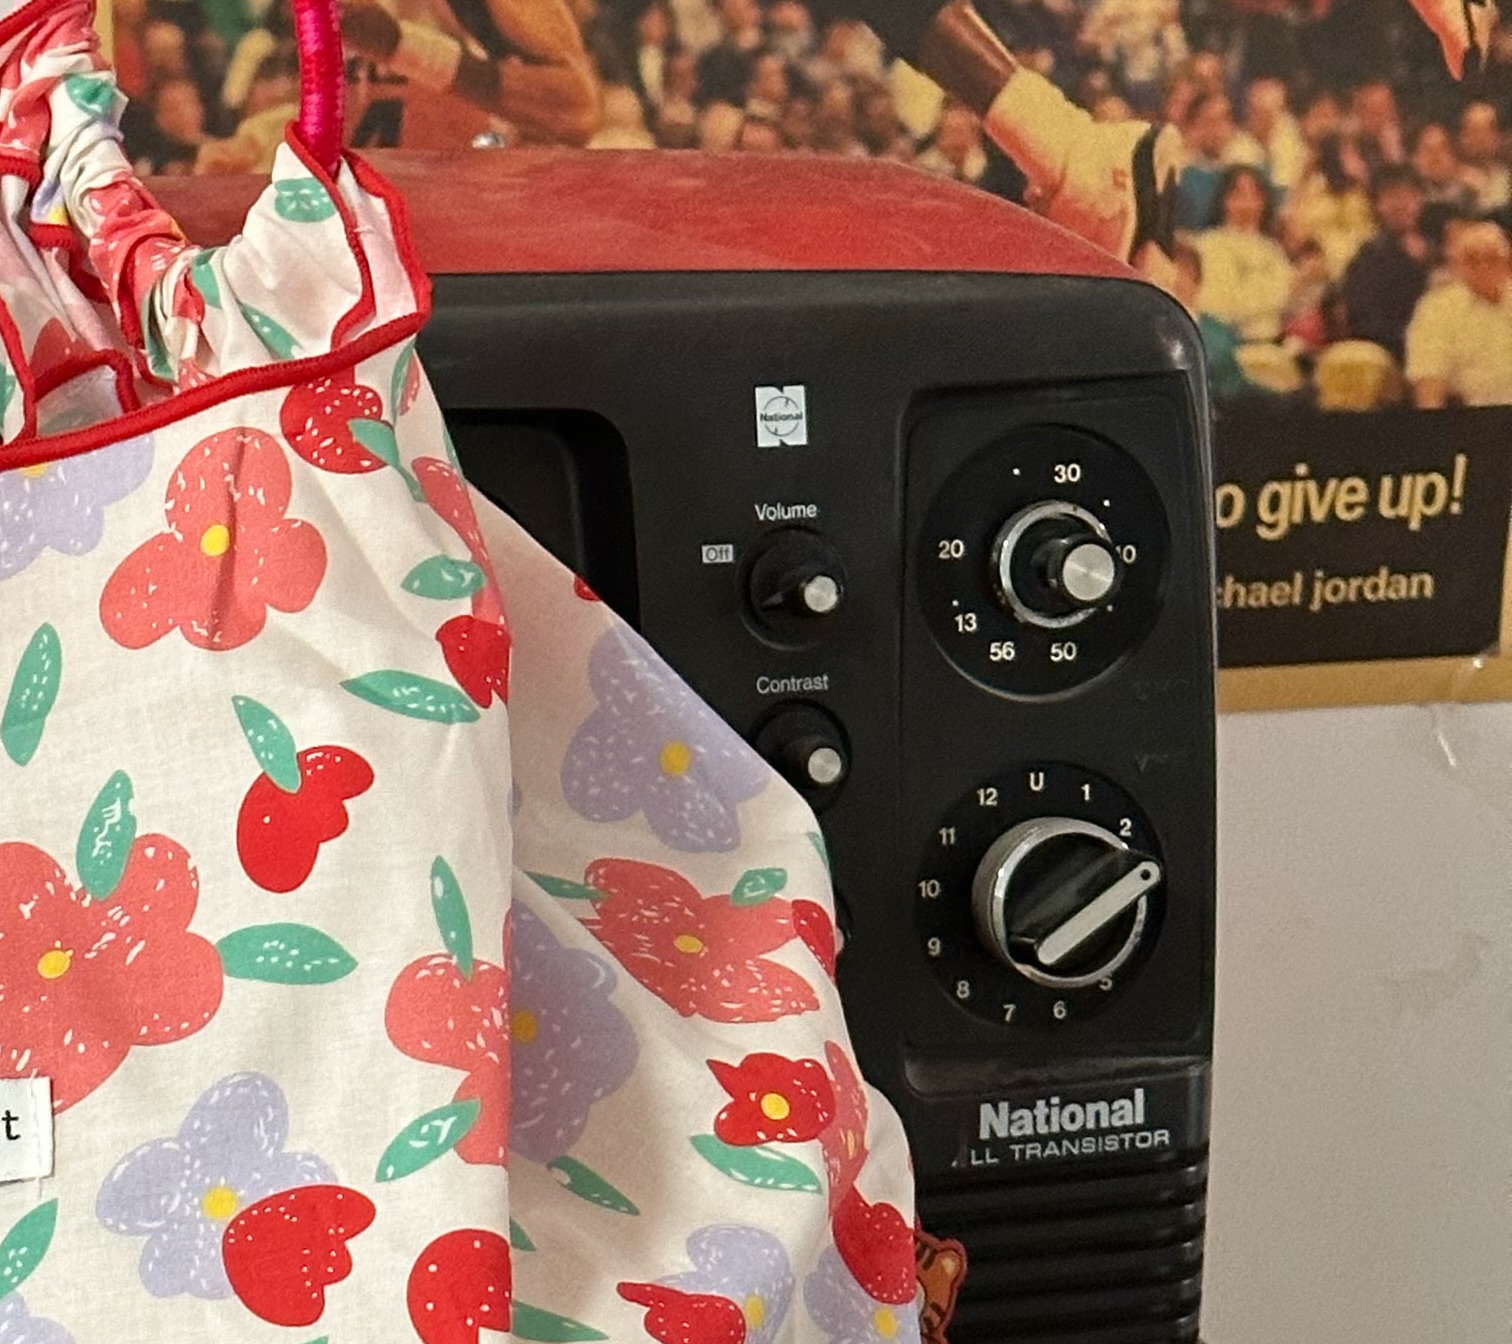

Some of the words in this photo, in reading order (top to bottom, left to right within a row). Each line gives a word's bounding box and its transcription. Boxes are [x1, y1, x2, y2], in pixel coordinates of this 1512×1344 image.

[1053, 463, 1081, 484] 30
[1256, 461, 1370, 541] give
[1378, 452, 1469, 532] up!
[754, 502, 818, 522] Volume
[938, 539, 965, 559] 20
[1115, 544, 1137, 565] 0
[1217, 570, 1303, 609] hael
[1309, 565, 1435, 613] jordan
[954, 612, 978, 632] 13
[989, 641, 1016, 662] 56
[1050, 641, 1077, 662] 50
[756, 674, 829, 695] Contrast
[1029, 771, 1045, 792] U
[977, 787, 998, 806] 12
[1081, 783, 1090, 801] 1
[939, 827, 956, 845] 11
[1118, 817, 1133, 837] 2
[918, 879, 941, 898] 10
[927, 937, 941, 957] 9
[956, 980, 970, 999] 8
[1003, 1003, 1016, 1022] 7
[1053, 1000, 1067, 1020] 6
[978, 1088, 1145, 1140] National
[1009, 1128, 1171, 1162] TRANSISTOR
